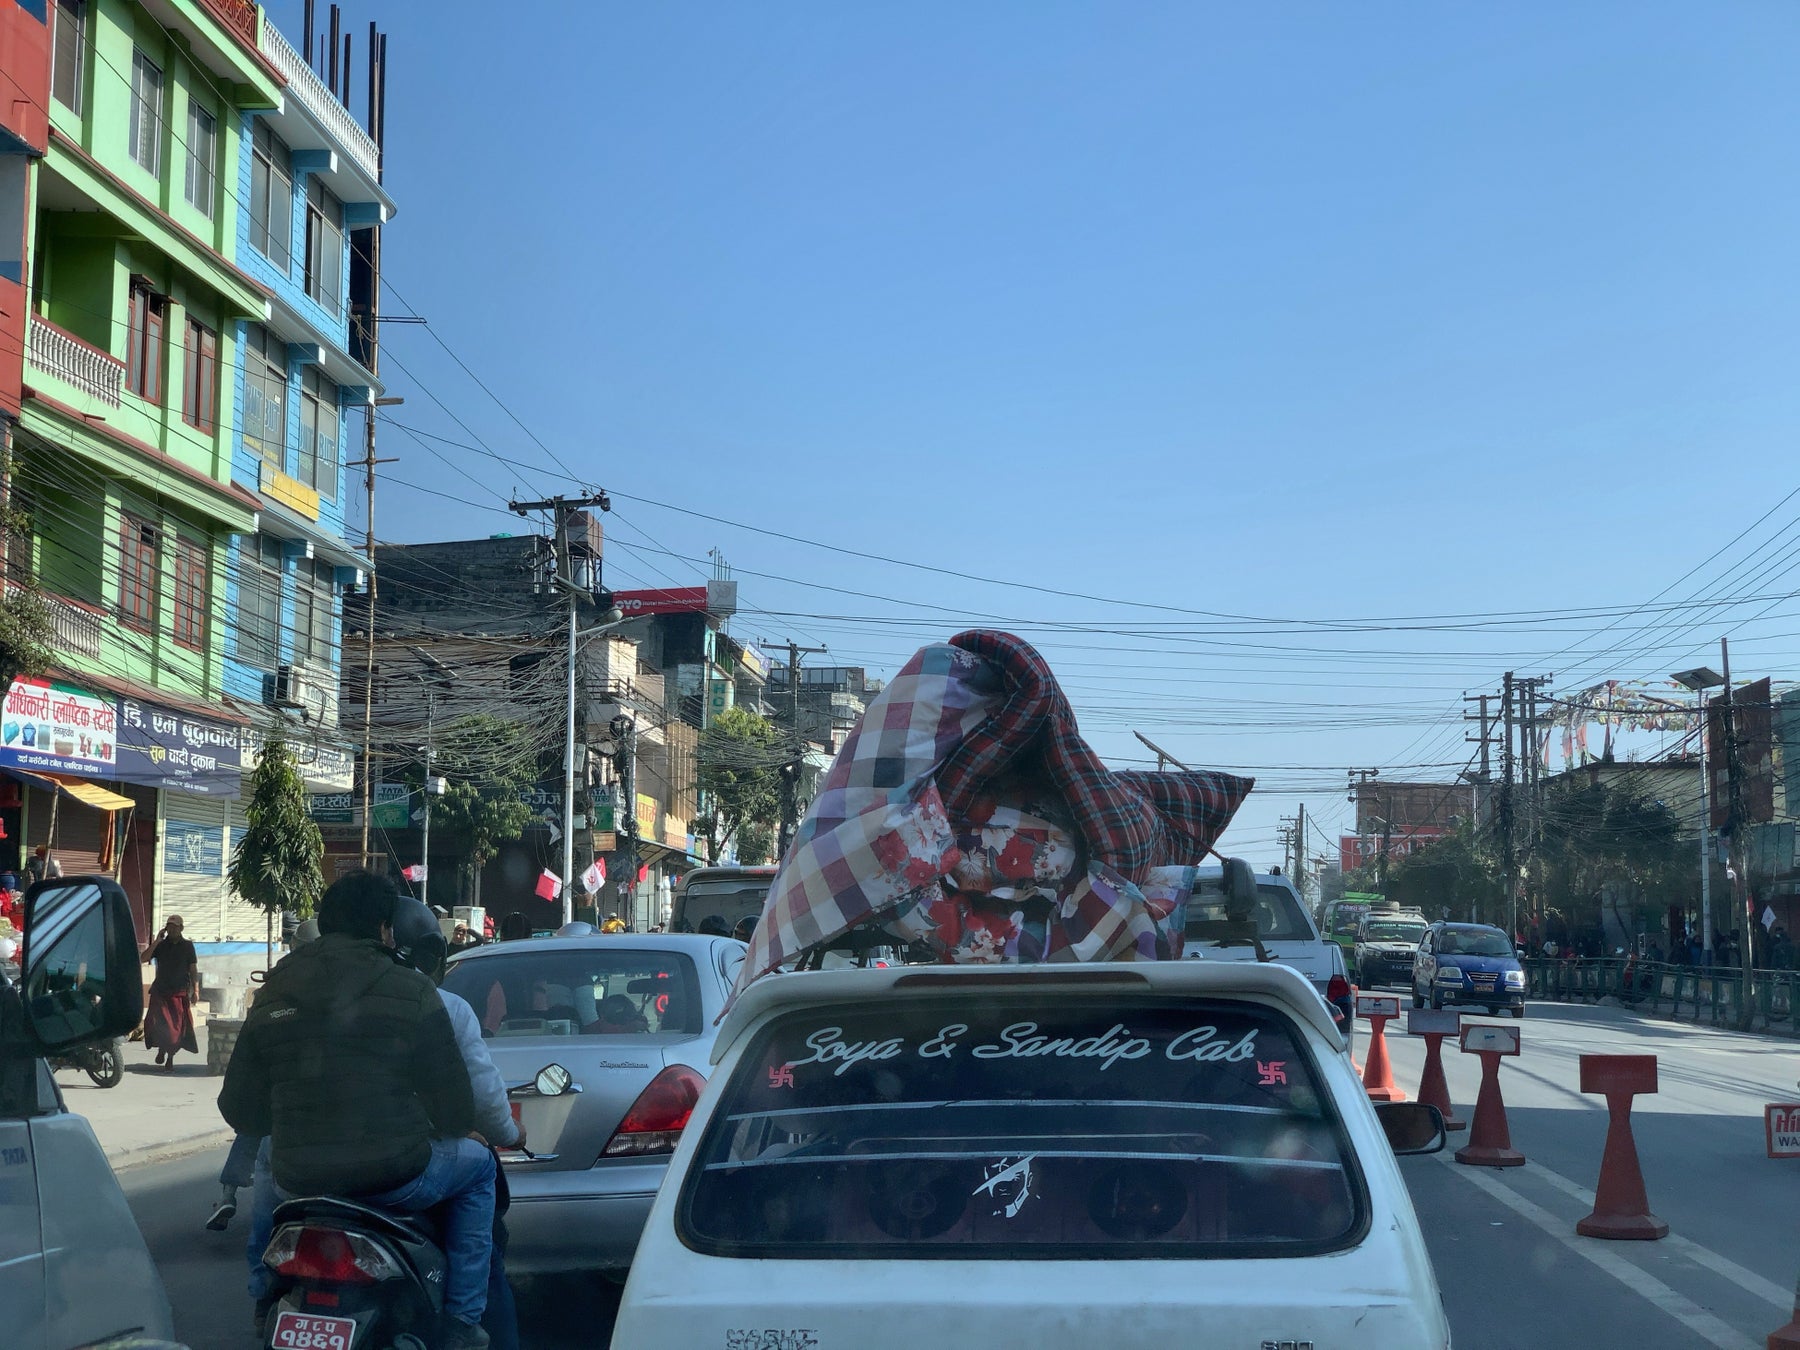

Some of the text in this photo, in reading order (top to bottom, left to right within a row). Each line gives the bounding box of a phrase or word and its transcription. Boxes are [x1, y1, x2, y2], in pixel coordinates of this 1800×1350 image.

[6, 685, 50, 721] अधिकारी
[149, 744, 166, 764] सुन
[190, 752, 216, 771] दुकान
[787, 1021, 1257, 1077] Soya & Sandip Cab
